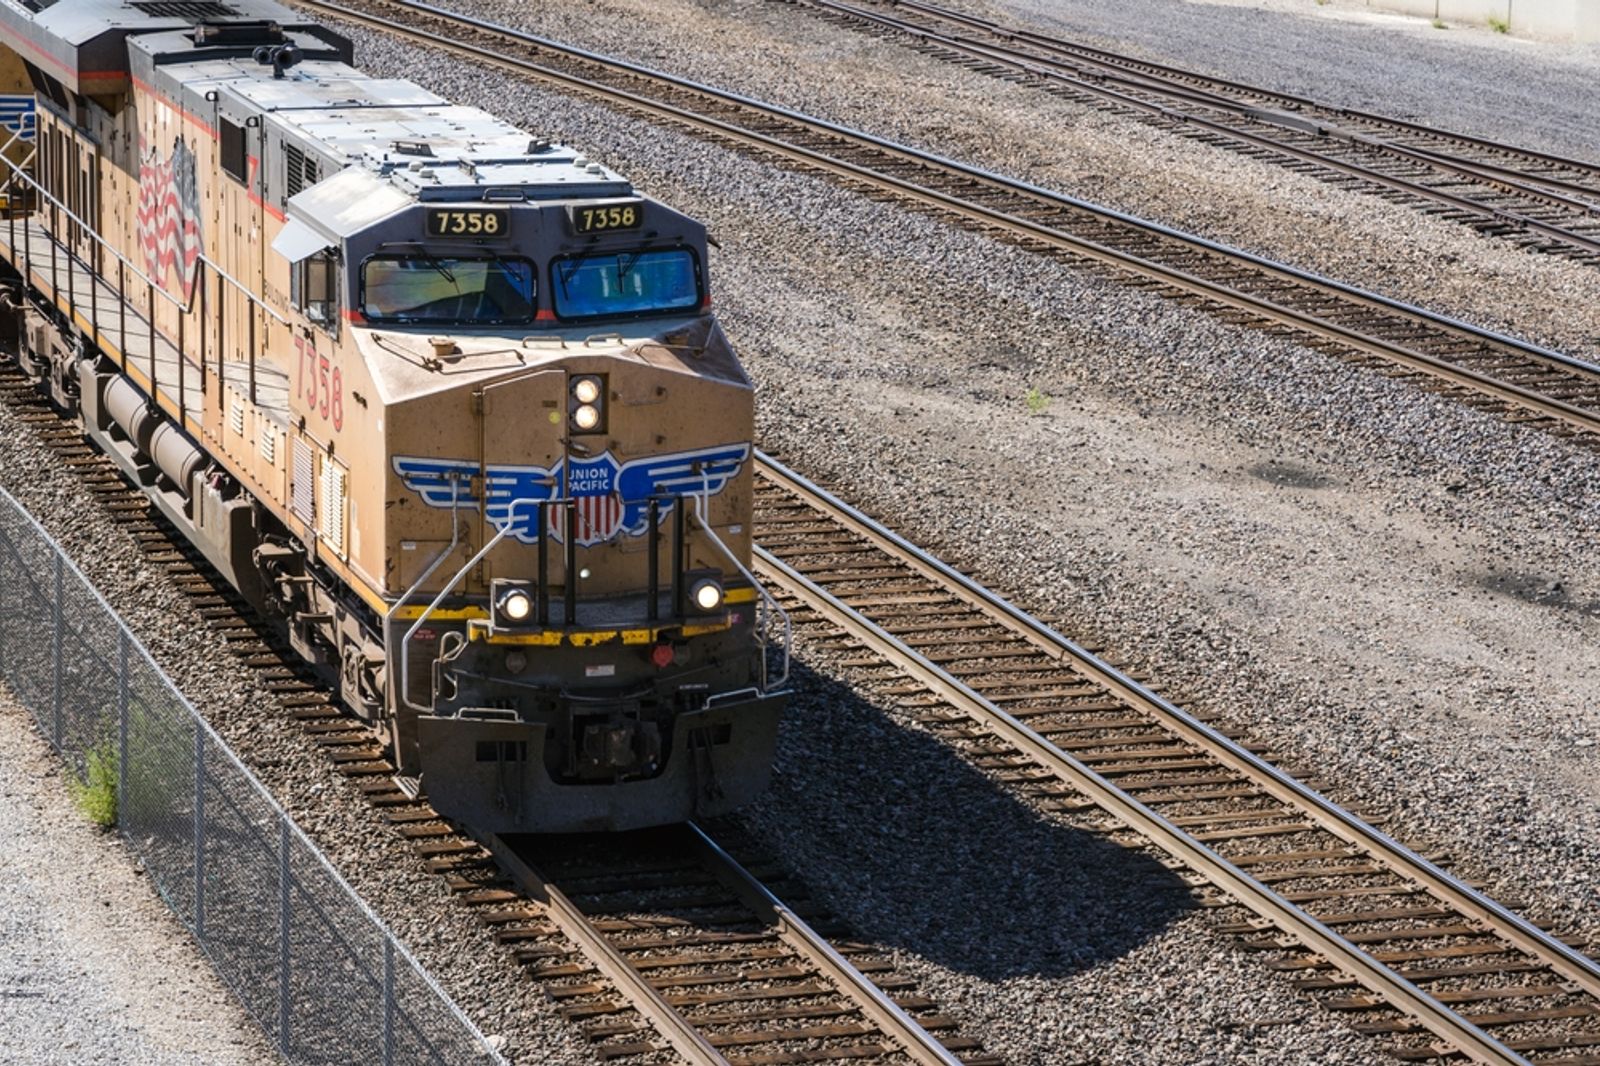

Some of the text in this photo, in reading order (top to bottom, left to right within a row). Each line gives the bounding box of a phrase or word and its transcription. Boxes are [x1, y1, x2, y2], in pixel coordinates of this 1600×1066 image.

[436, 212, 498, 234] 7358
[582, 207, 636, 231] 7358
[294, 334, 343, 432] 7358
